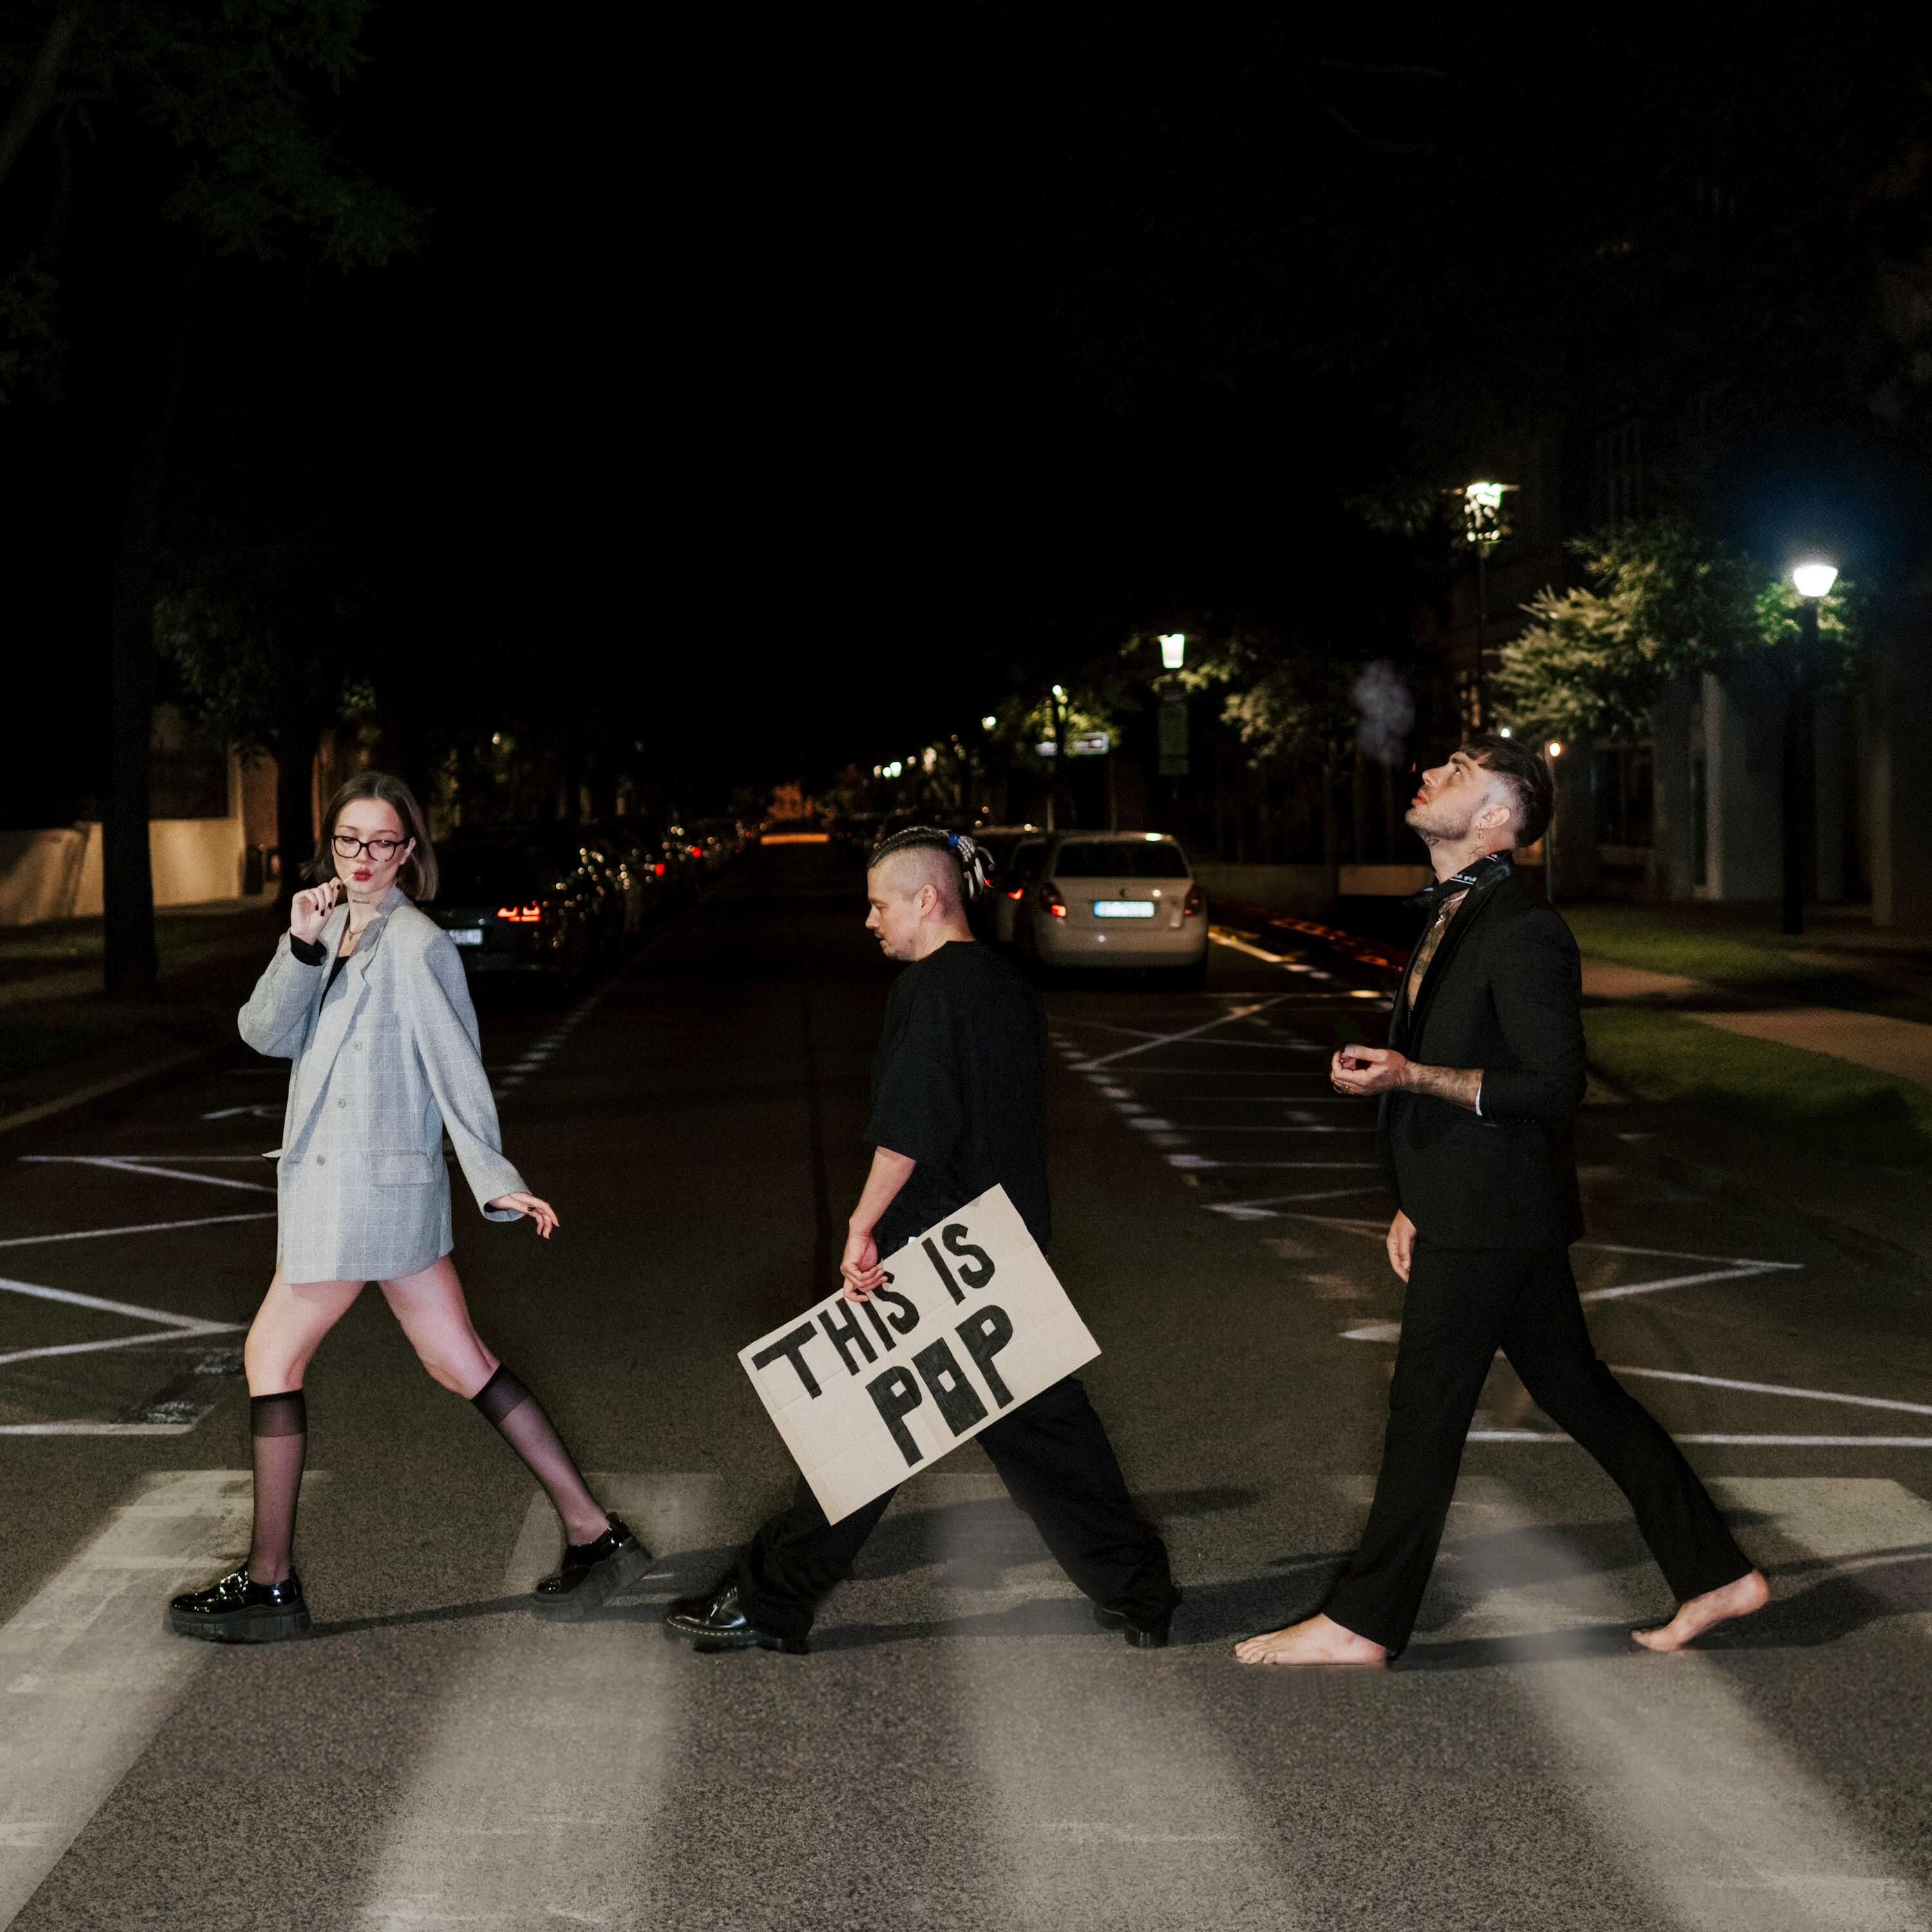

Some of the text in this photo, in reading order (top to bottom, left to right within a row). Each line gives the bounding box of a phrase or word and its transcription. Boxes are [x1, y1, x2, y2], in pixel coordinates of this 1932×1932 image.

[752, 1223, 996, 1400] THIS IS
[865, 1305, 1015, 1468] POP
